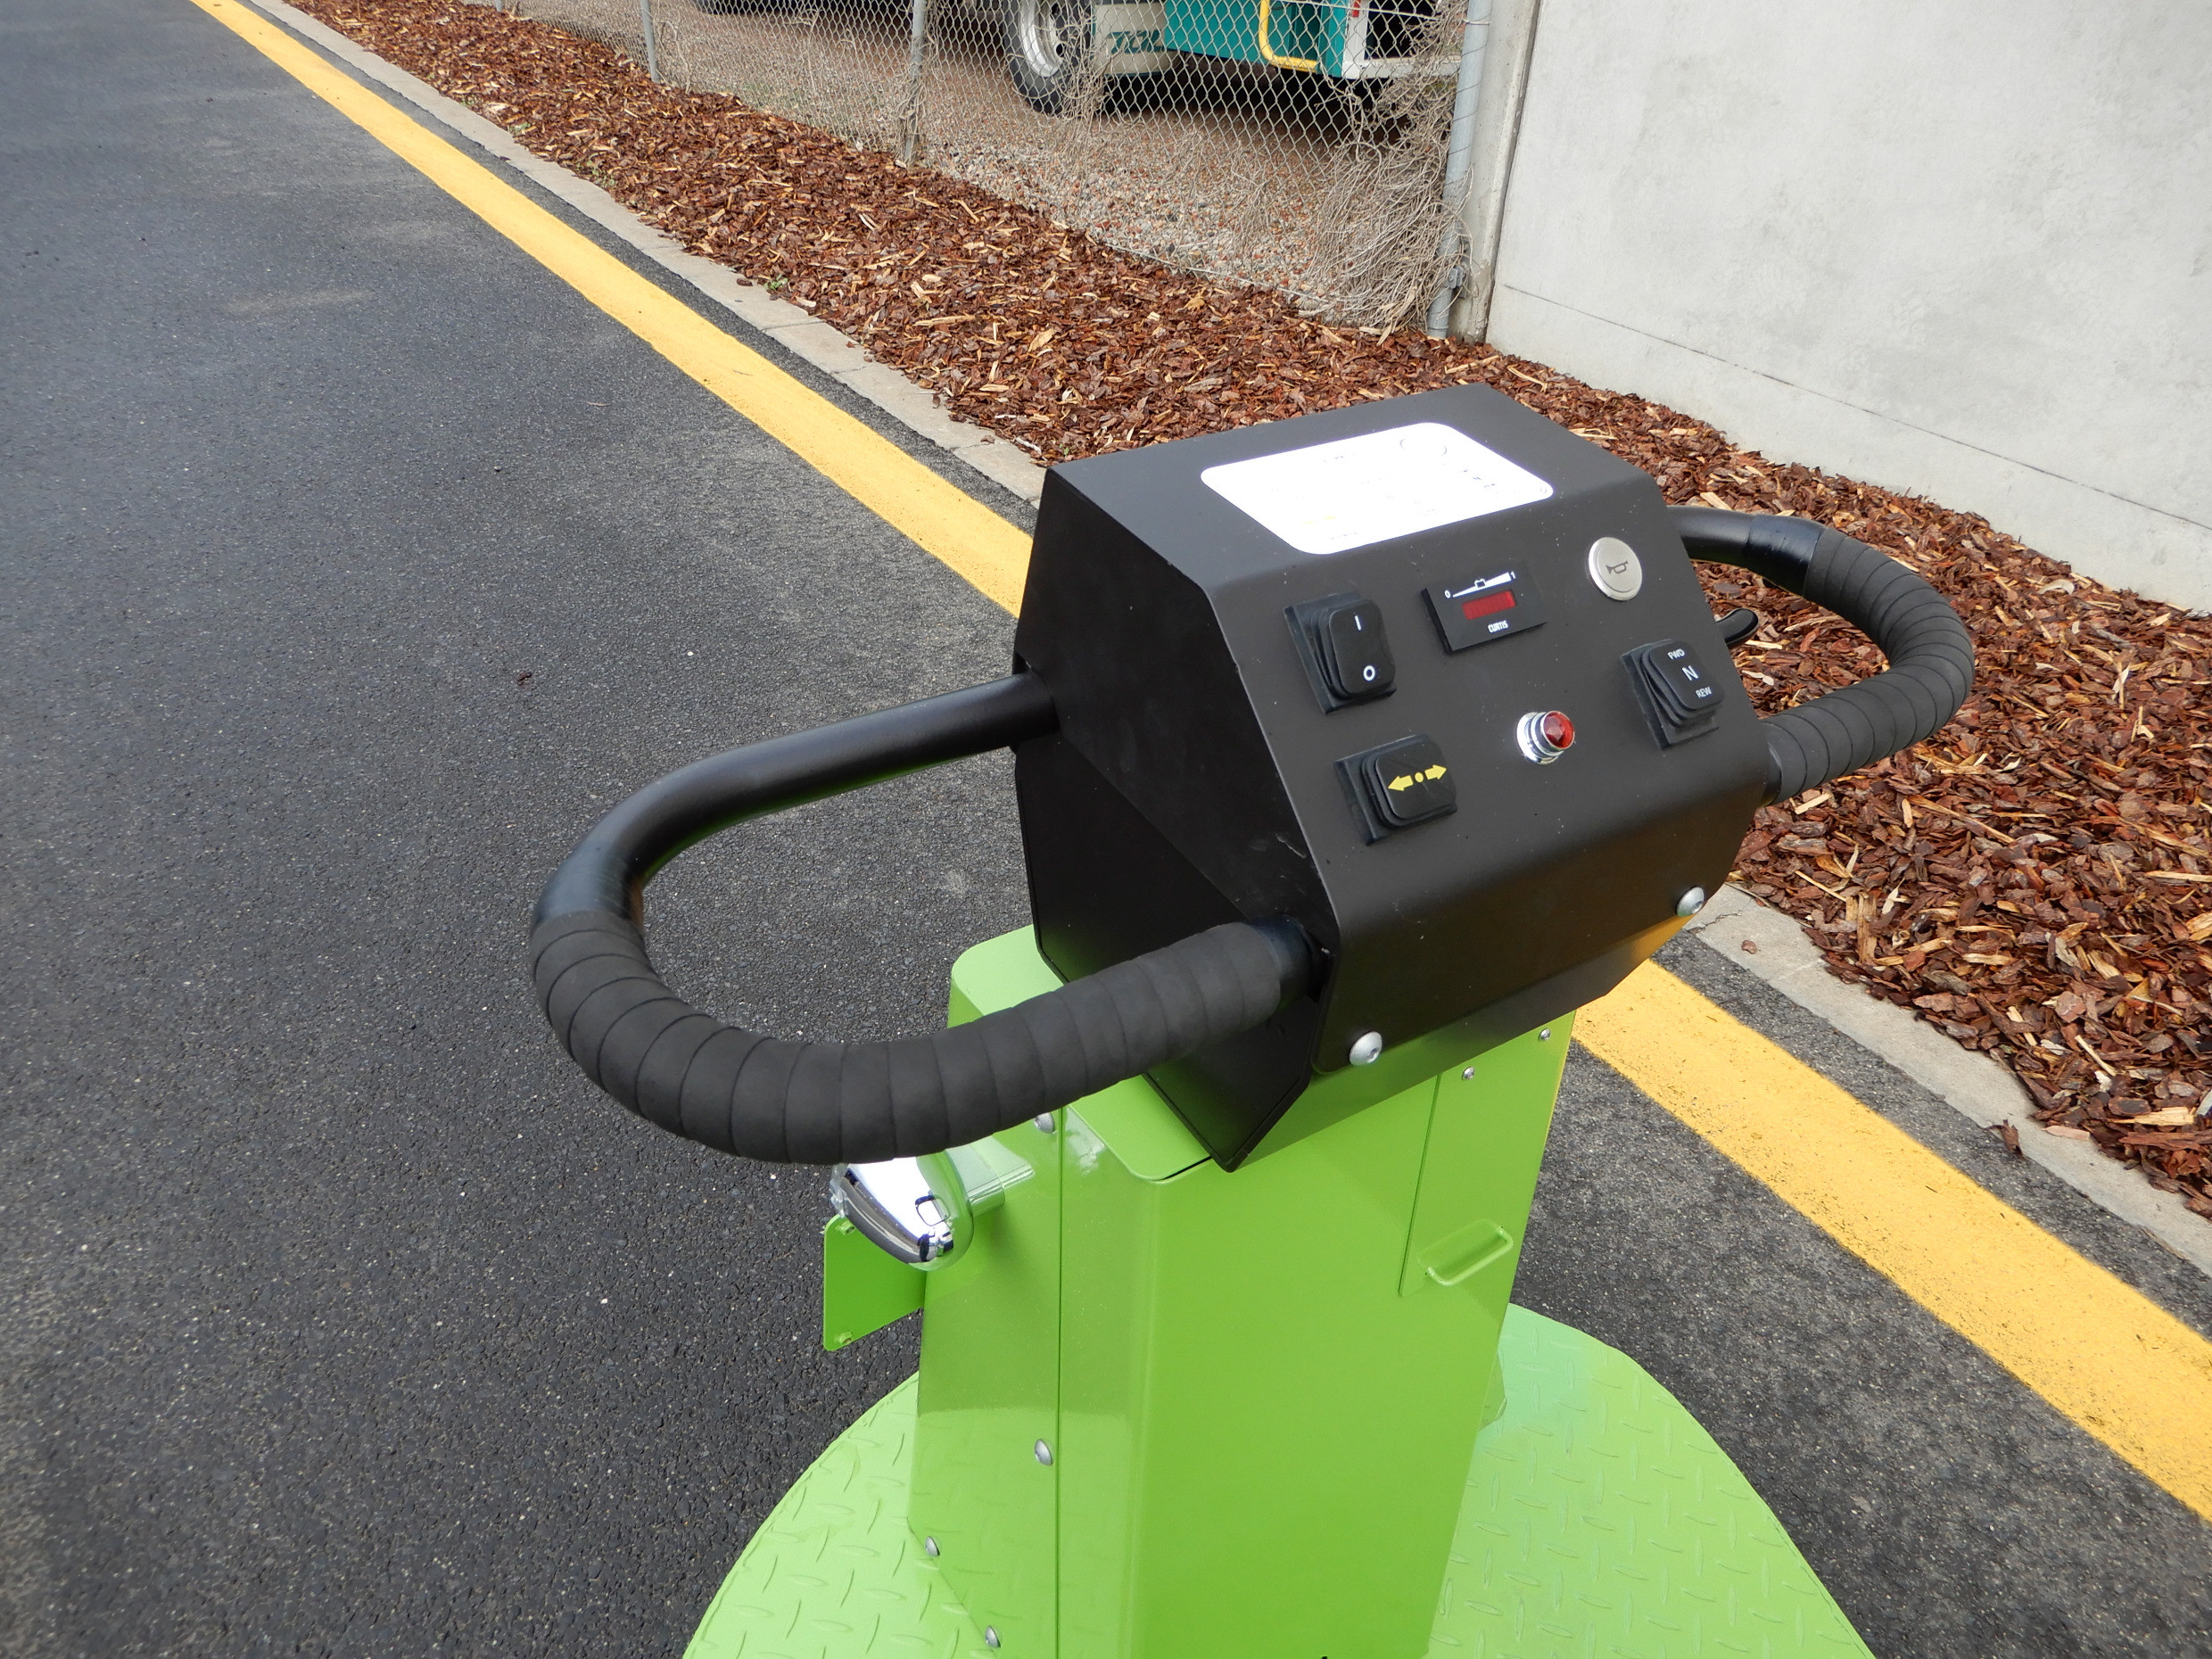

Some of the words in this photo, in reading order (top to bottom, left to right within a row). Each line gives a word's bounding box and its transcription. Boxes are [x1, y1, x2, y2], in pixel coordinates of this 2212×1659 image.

[1487, 620, 1509, 633] CURTIS
[1667, 648, 1686, 660] FWD
[1681, 664, 1699, 681] N
[1695, 686, 1713, 698] REW
